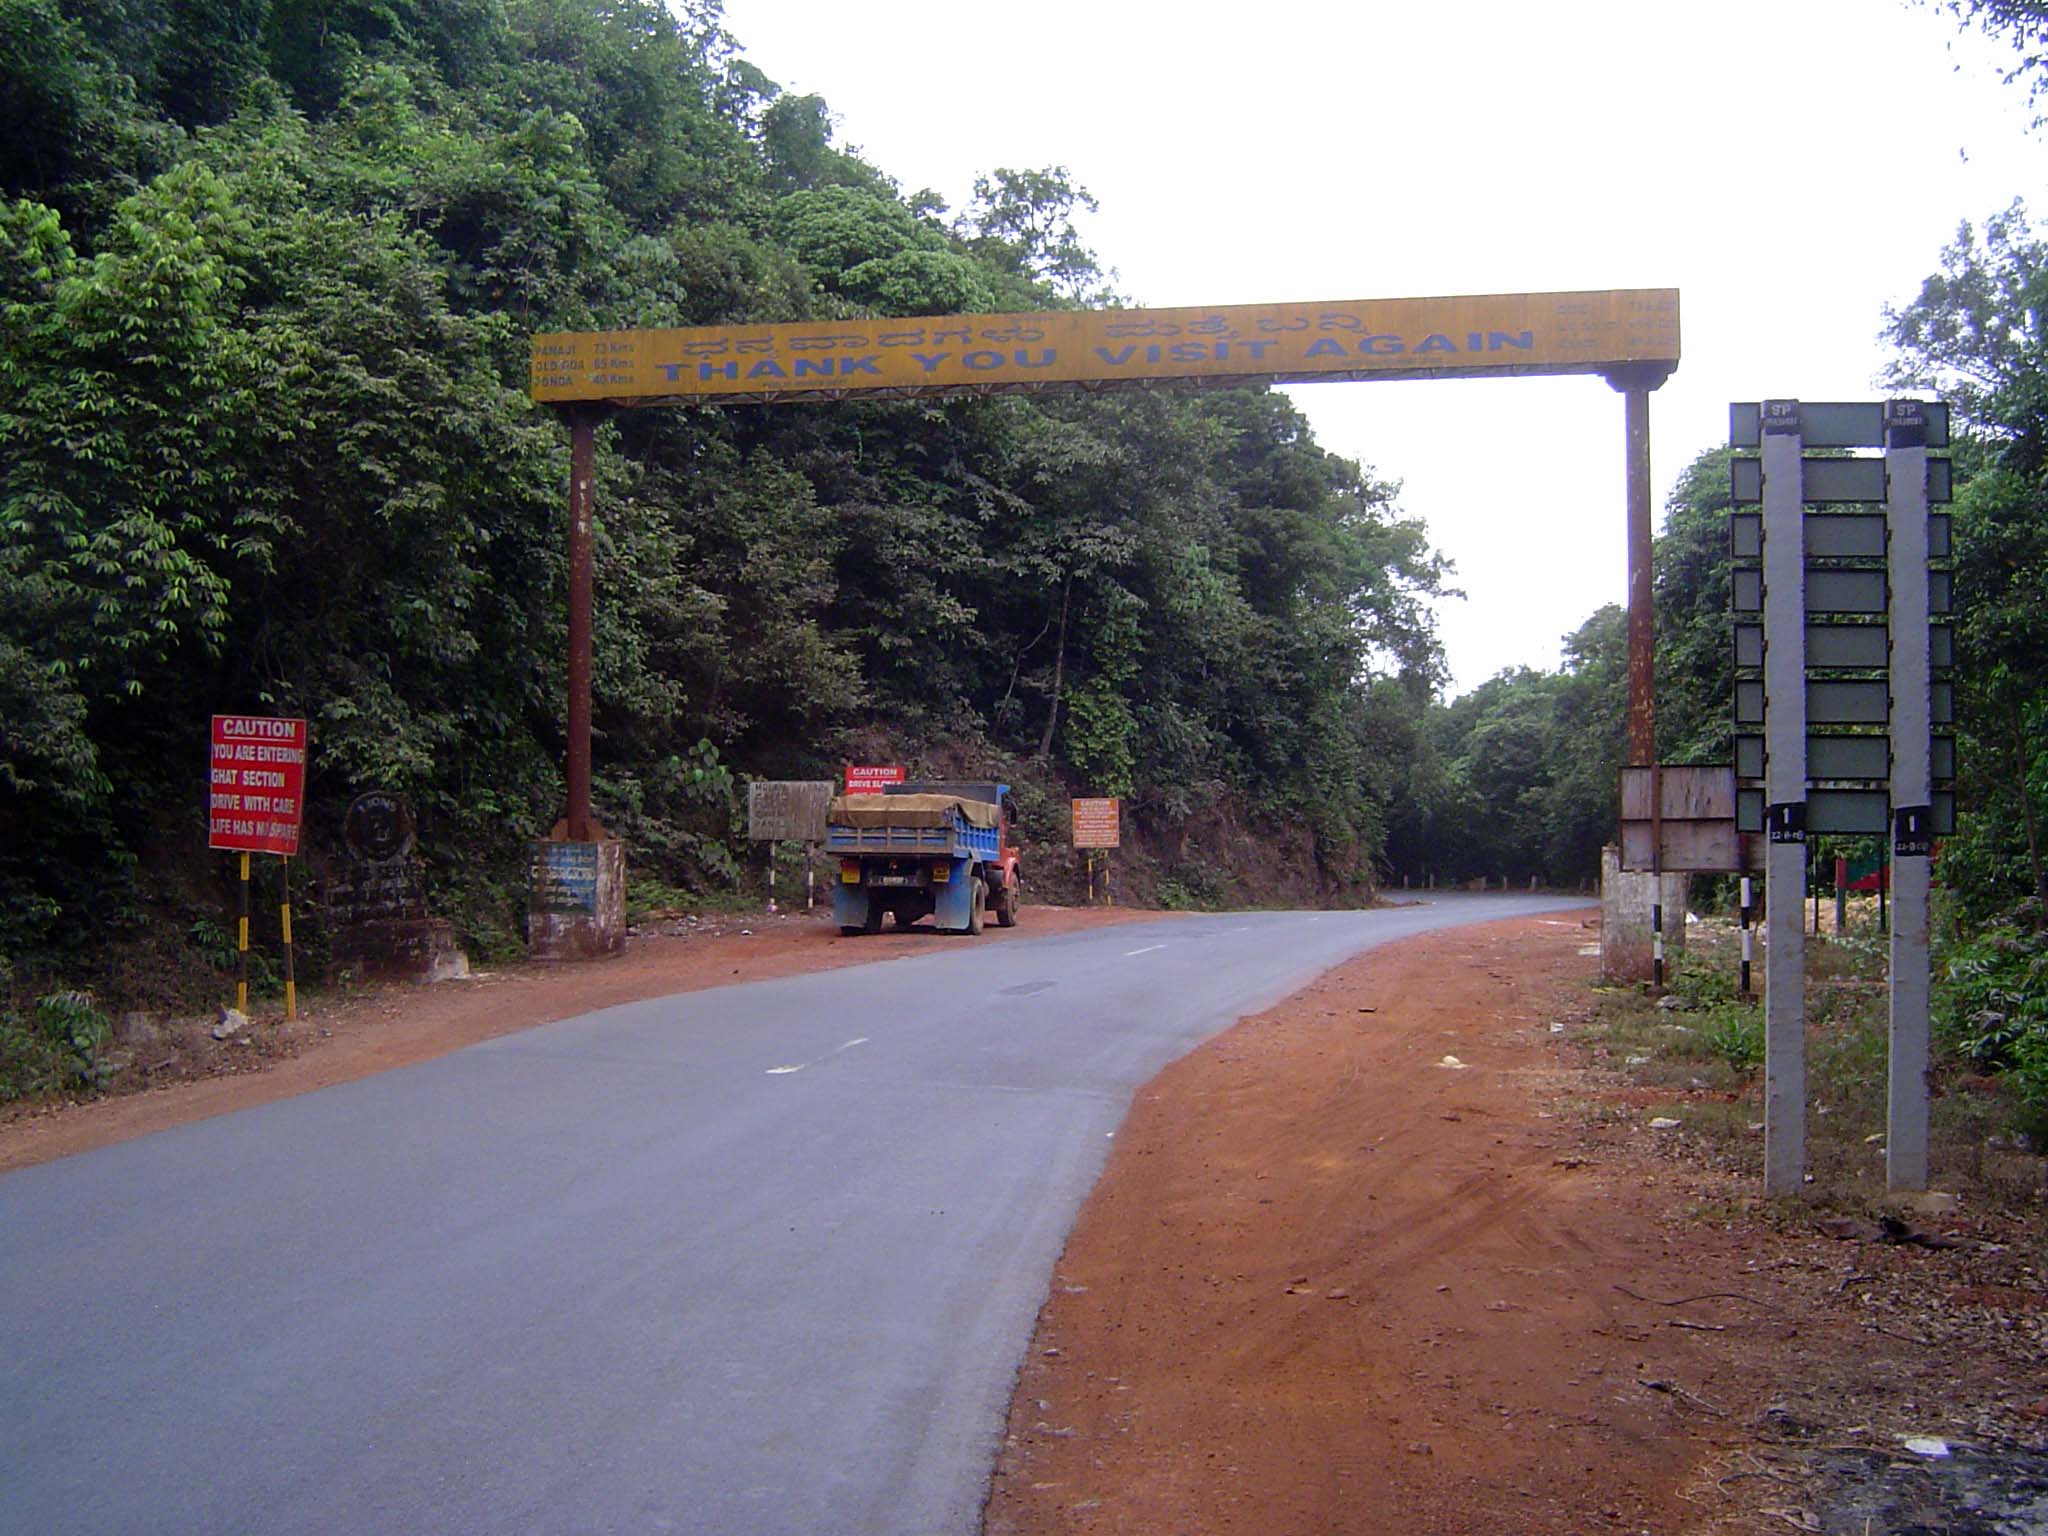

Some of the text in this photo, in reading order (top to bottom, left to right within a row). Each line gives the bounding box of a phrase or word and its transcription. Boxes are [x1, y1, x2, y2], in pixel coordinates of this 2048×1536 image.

[655, 354, 883, 383] THANK
[911, 347, 1058, 373] YOU
[1096, 339, 1279, 366] VISIT
[1304, 330, 1535, 359] AGAIN
[223, 719, 296, 738] CAUTION
[214, 744, 304, 764] YOU ARE ENTERING
[212, 768, 285, 788] GHAT SECTION
[853, 768, 897, 776] CAUTION
[211, 793, 295, 814] DRIVE WITH CARE
[210, 818, 231, 835] LIFE
[233, 820, 254, 836] HAS
